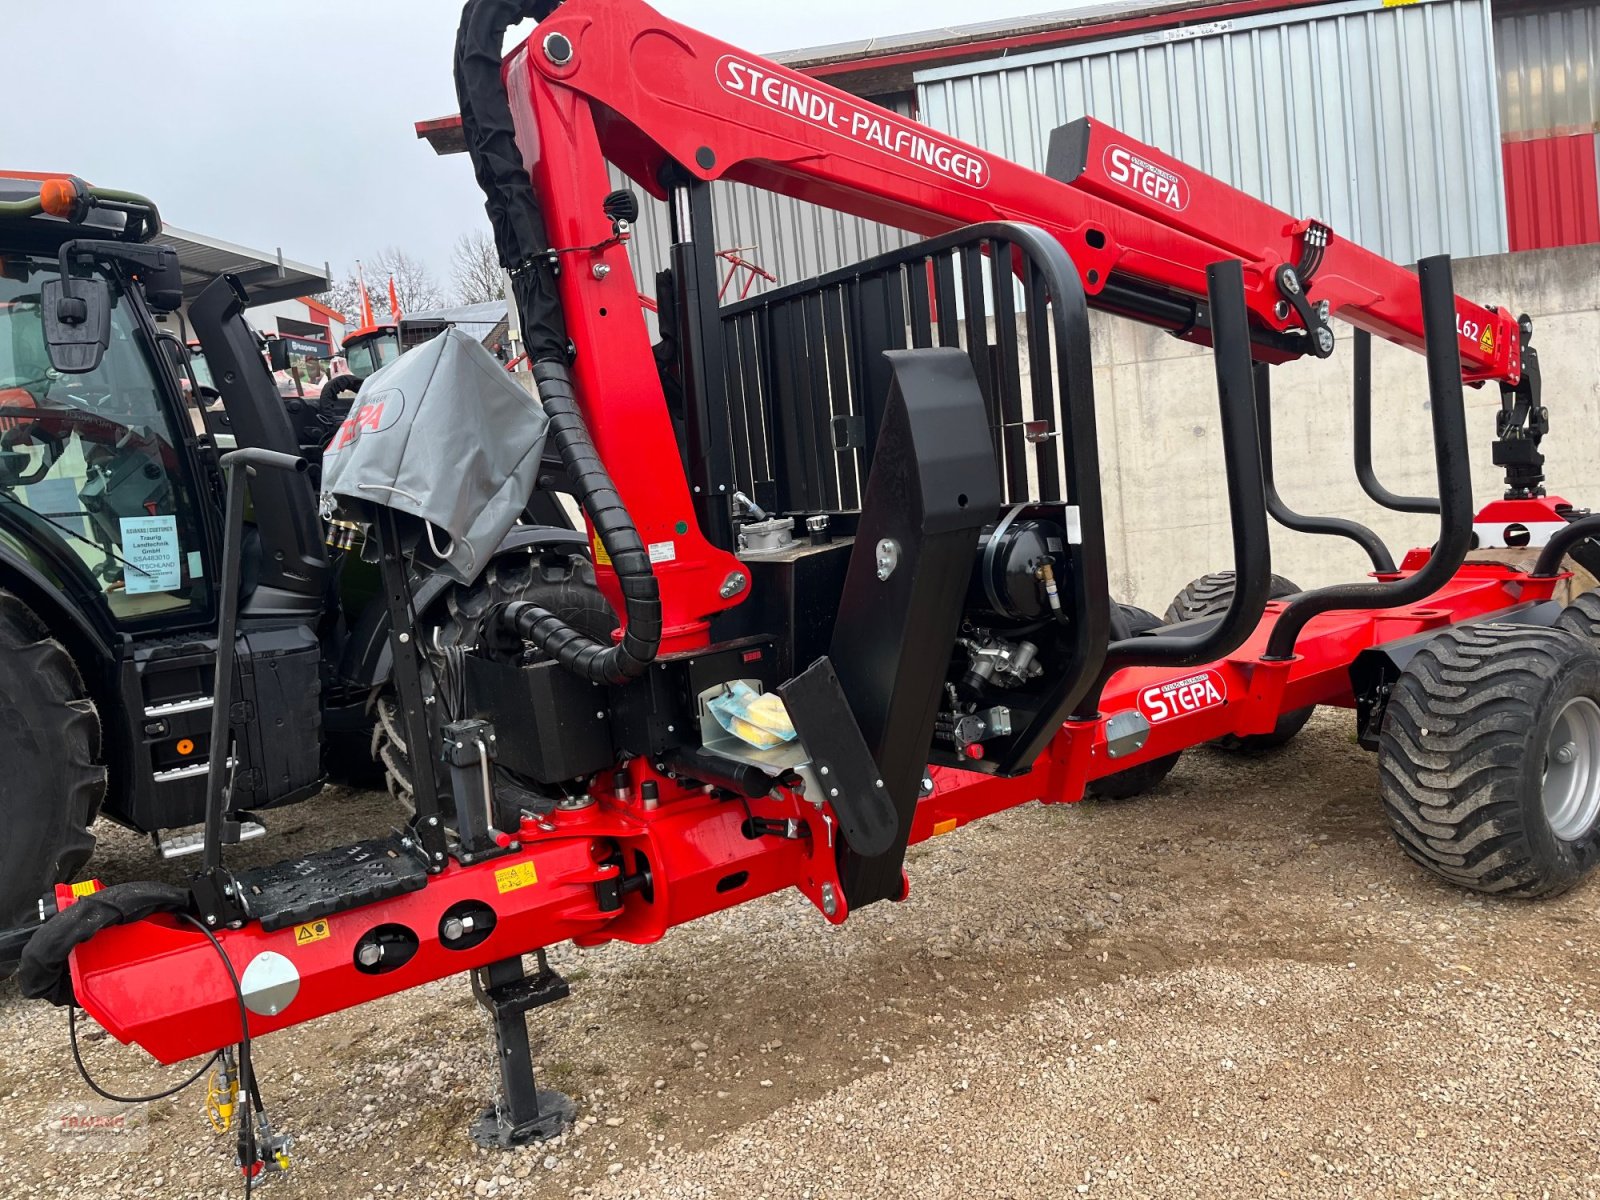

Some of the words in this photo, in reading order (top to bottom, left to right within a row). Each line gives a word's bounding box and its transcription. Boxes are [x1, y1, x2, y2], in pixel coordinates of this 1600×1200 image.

[726, 61, 982, 184] STEINDL-PALFINGER
[1110, 148, 1180, 209] STEPA
[1143, 680, 1222, 721] STEPA
